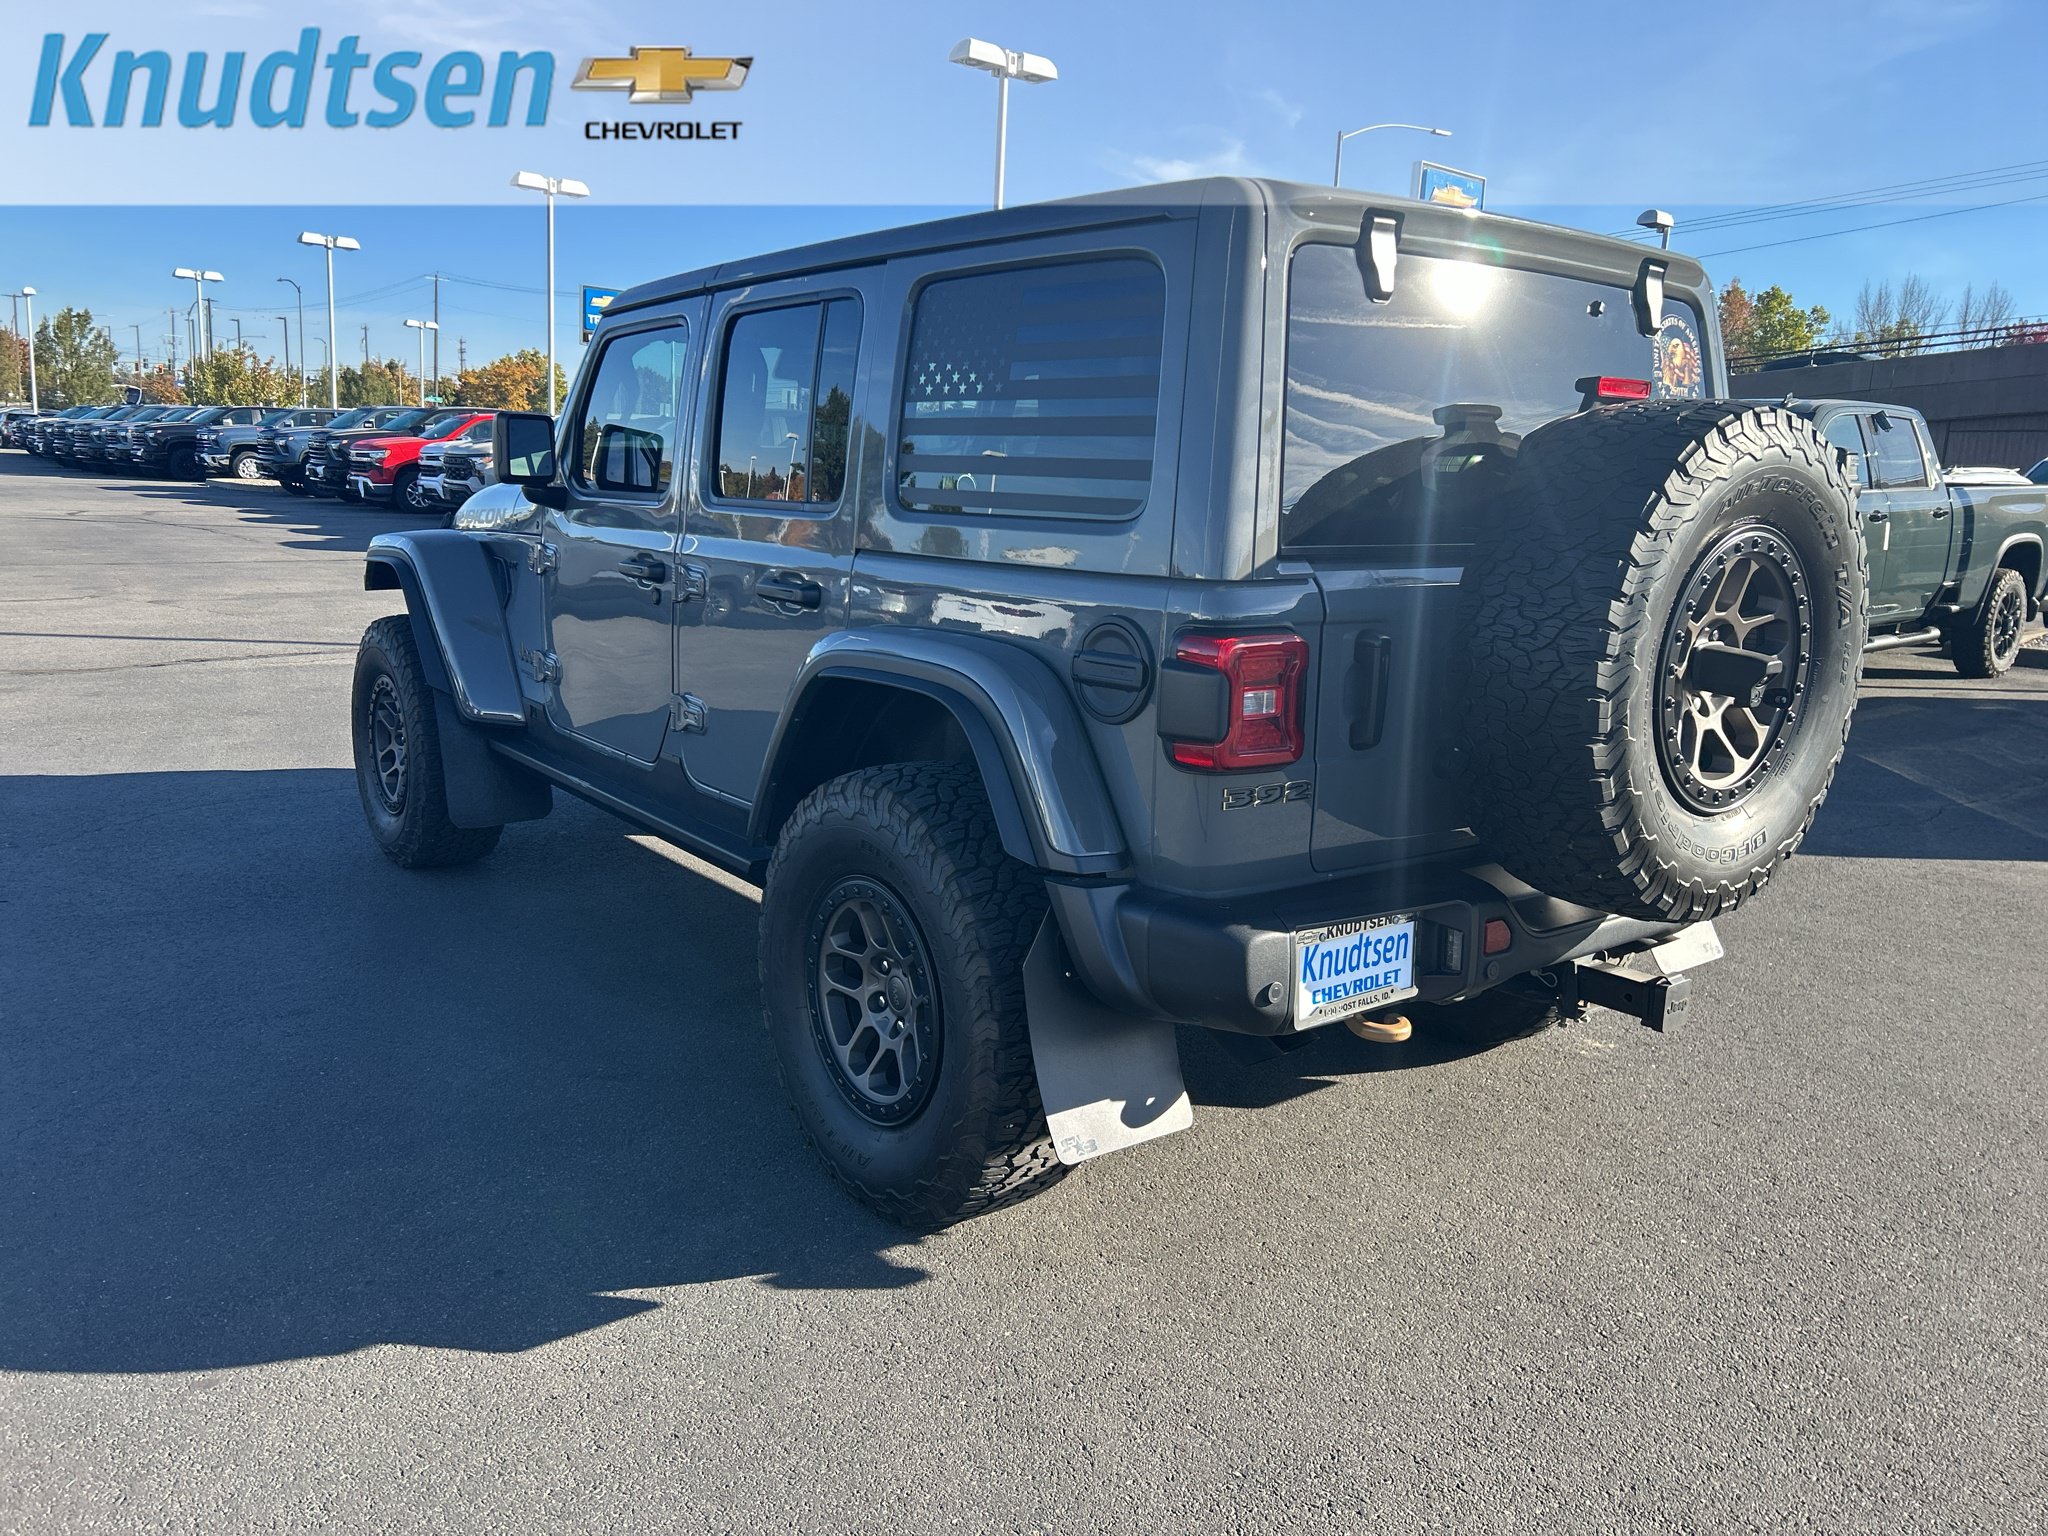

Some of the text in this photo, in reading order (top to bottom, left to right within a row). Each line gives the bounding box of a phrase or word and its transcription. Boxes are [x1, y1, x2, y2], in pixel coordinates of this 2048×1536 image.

[1221, 779, 1313, 811] 392
[1648, 762, 1768, 865] BFGoodrich
[1326, 916, 1394, 940] KNUDTSEN
[1301, 932, 1409, 984] Knudtsen
[1311, 968, 1401, 1005] CHEVROLET
